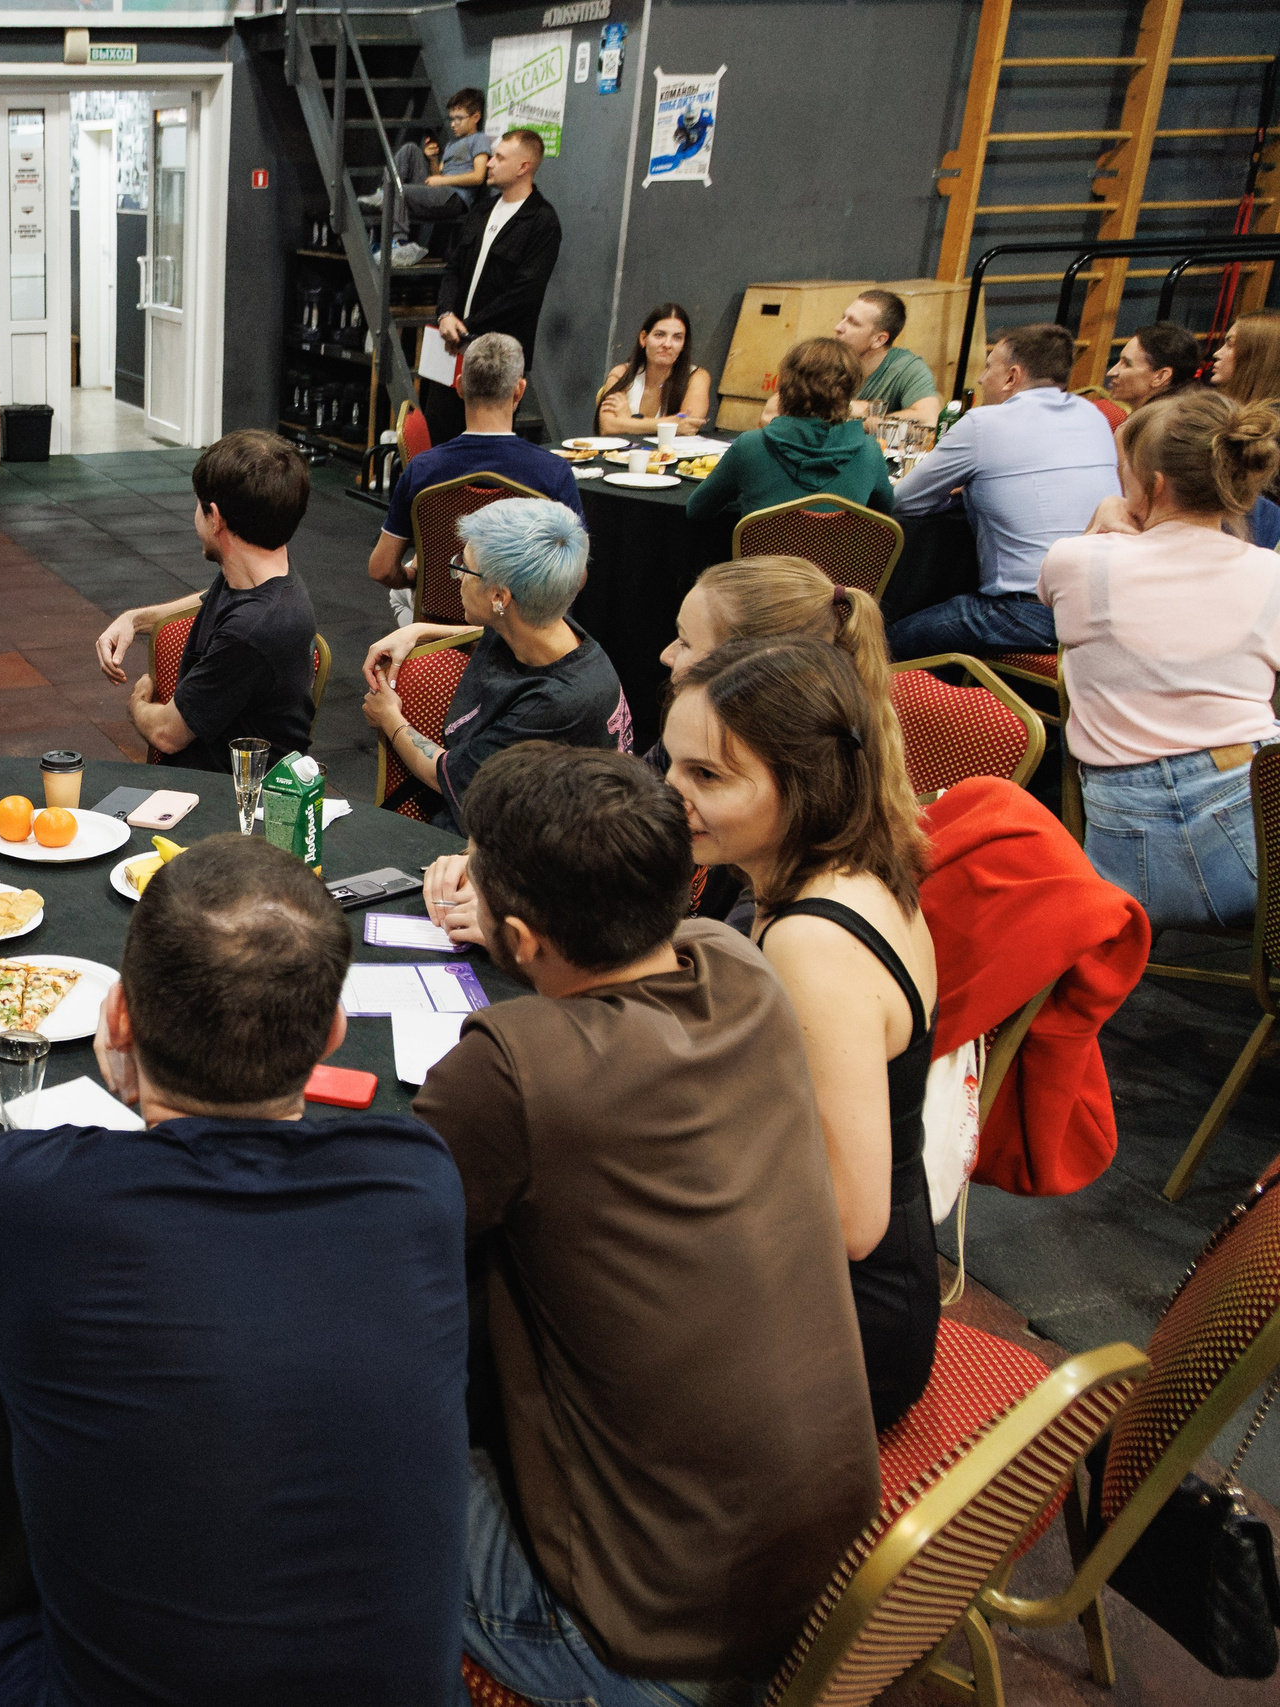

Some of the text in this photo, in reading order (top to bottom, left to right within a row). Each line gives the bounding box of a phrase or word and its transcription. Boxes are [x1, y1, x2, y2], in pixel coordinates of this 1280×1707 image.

[92, 48, 132, 60] ВЫХОД
[491, 56, 556, 109] МАССАЖ
[304, 803, 318, 864] Добрый
